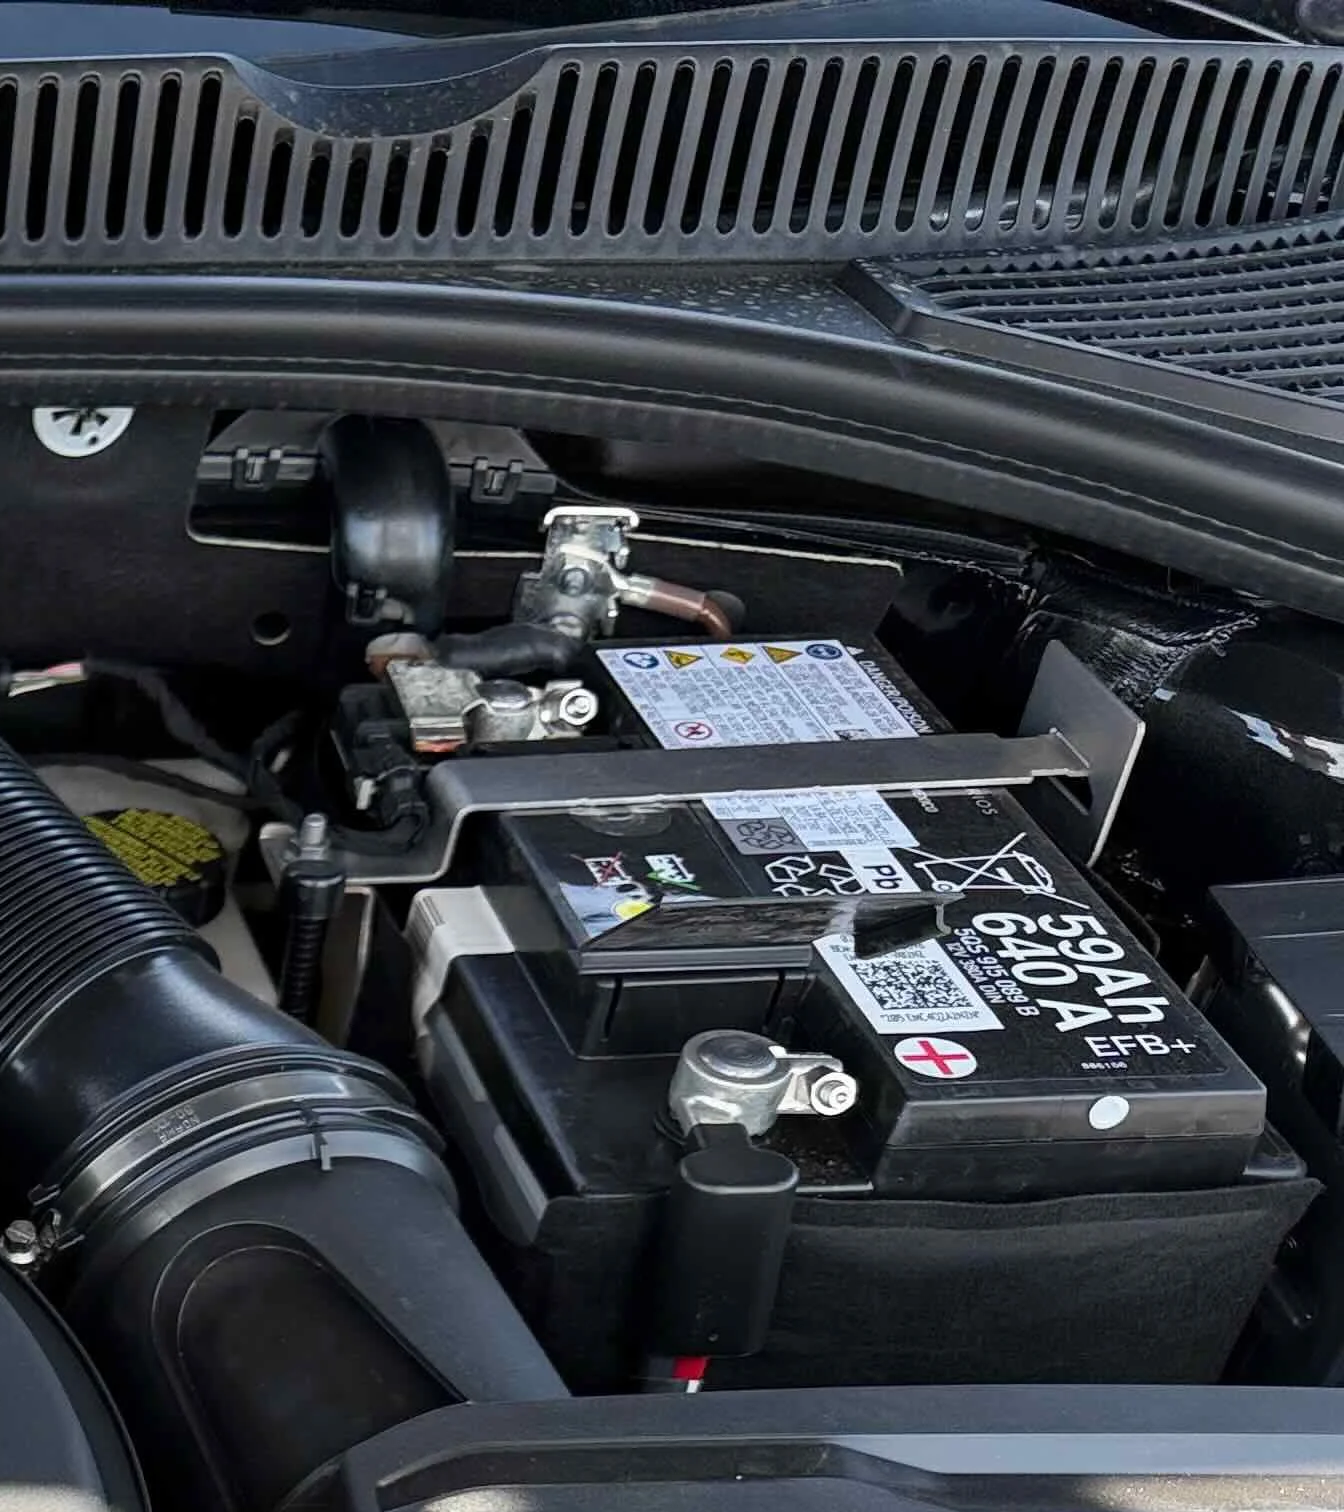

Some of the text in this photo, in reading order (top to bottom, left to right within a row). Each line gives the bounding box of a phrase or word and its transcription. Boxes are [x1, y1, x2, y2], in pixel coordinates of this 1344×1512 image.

[860, 660, 934, 734] DANGER/POISON
[864, 864, 900, 890] Pb
[972, 912, 1112, 1032] 640 A
[976, 956, 1009, 976] 915
[995, 975, 1030, 1003] 089
[1016, 1003, 1041, 1017] B
[979, 984, 1008, 1004] DIN
[1037, 913, 1169, 1024] 59Ah
[1084, 1034, 1196, 1057] EFB+
